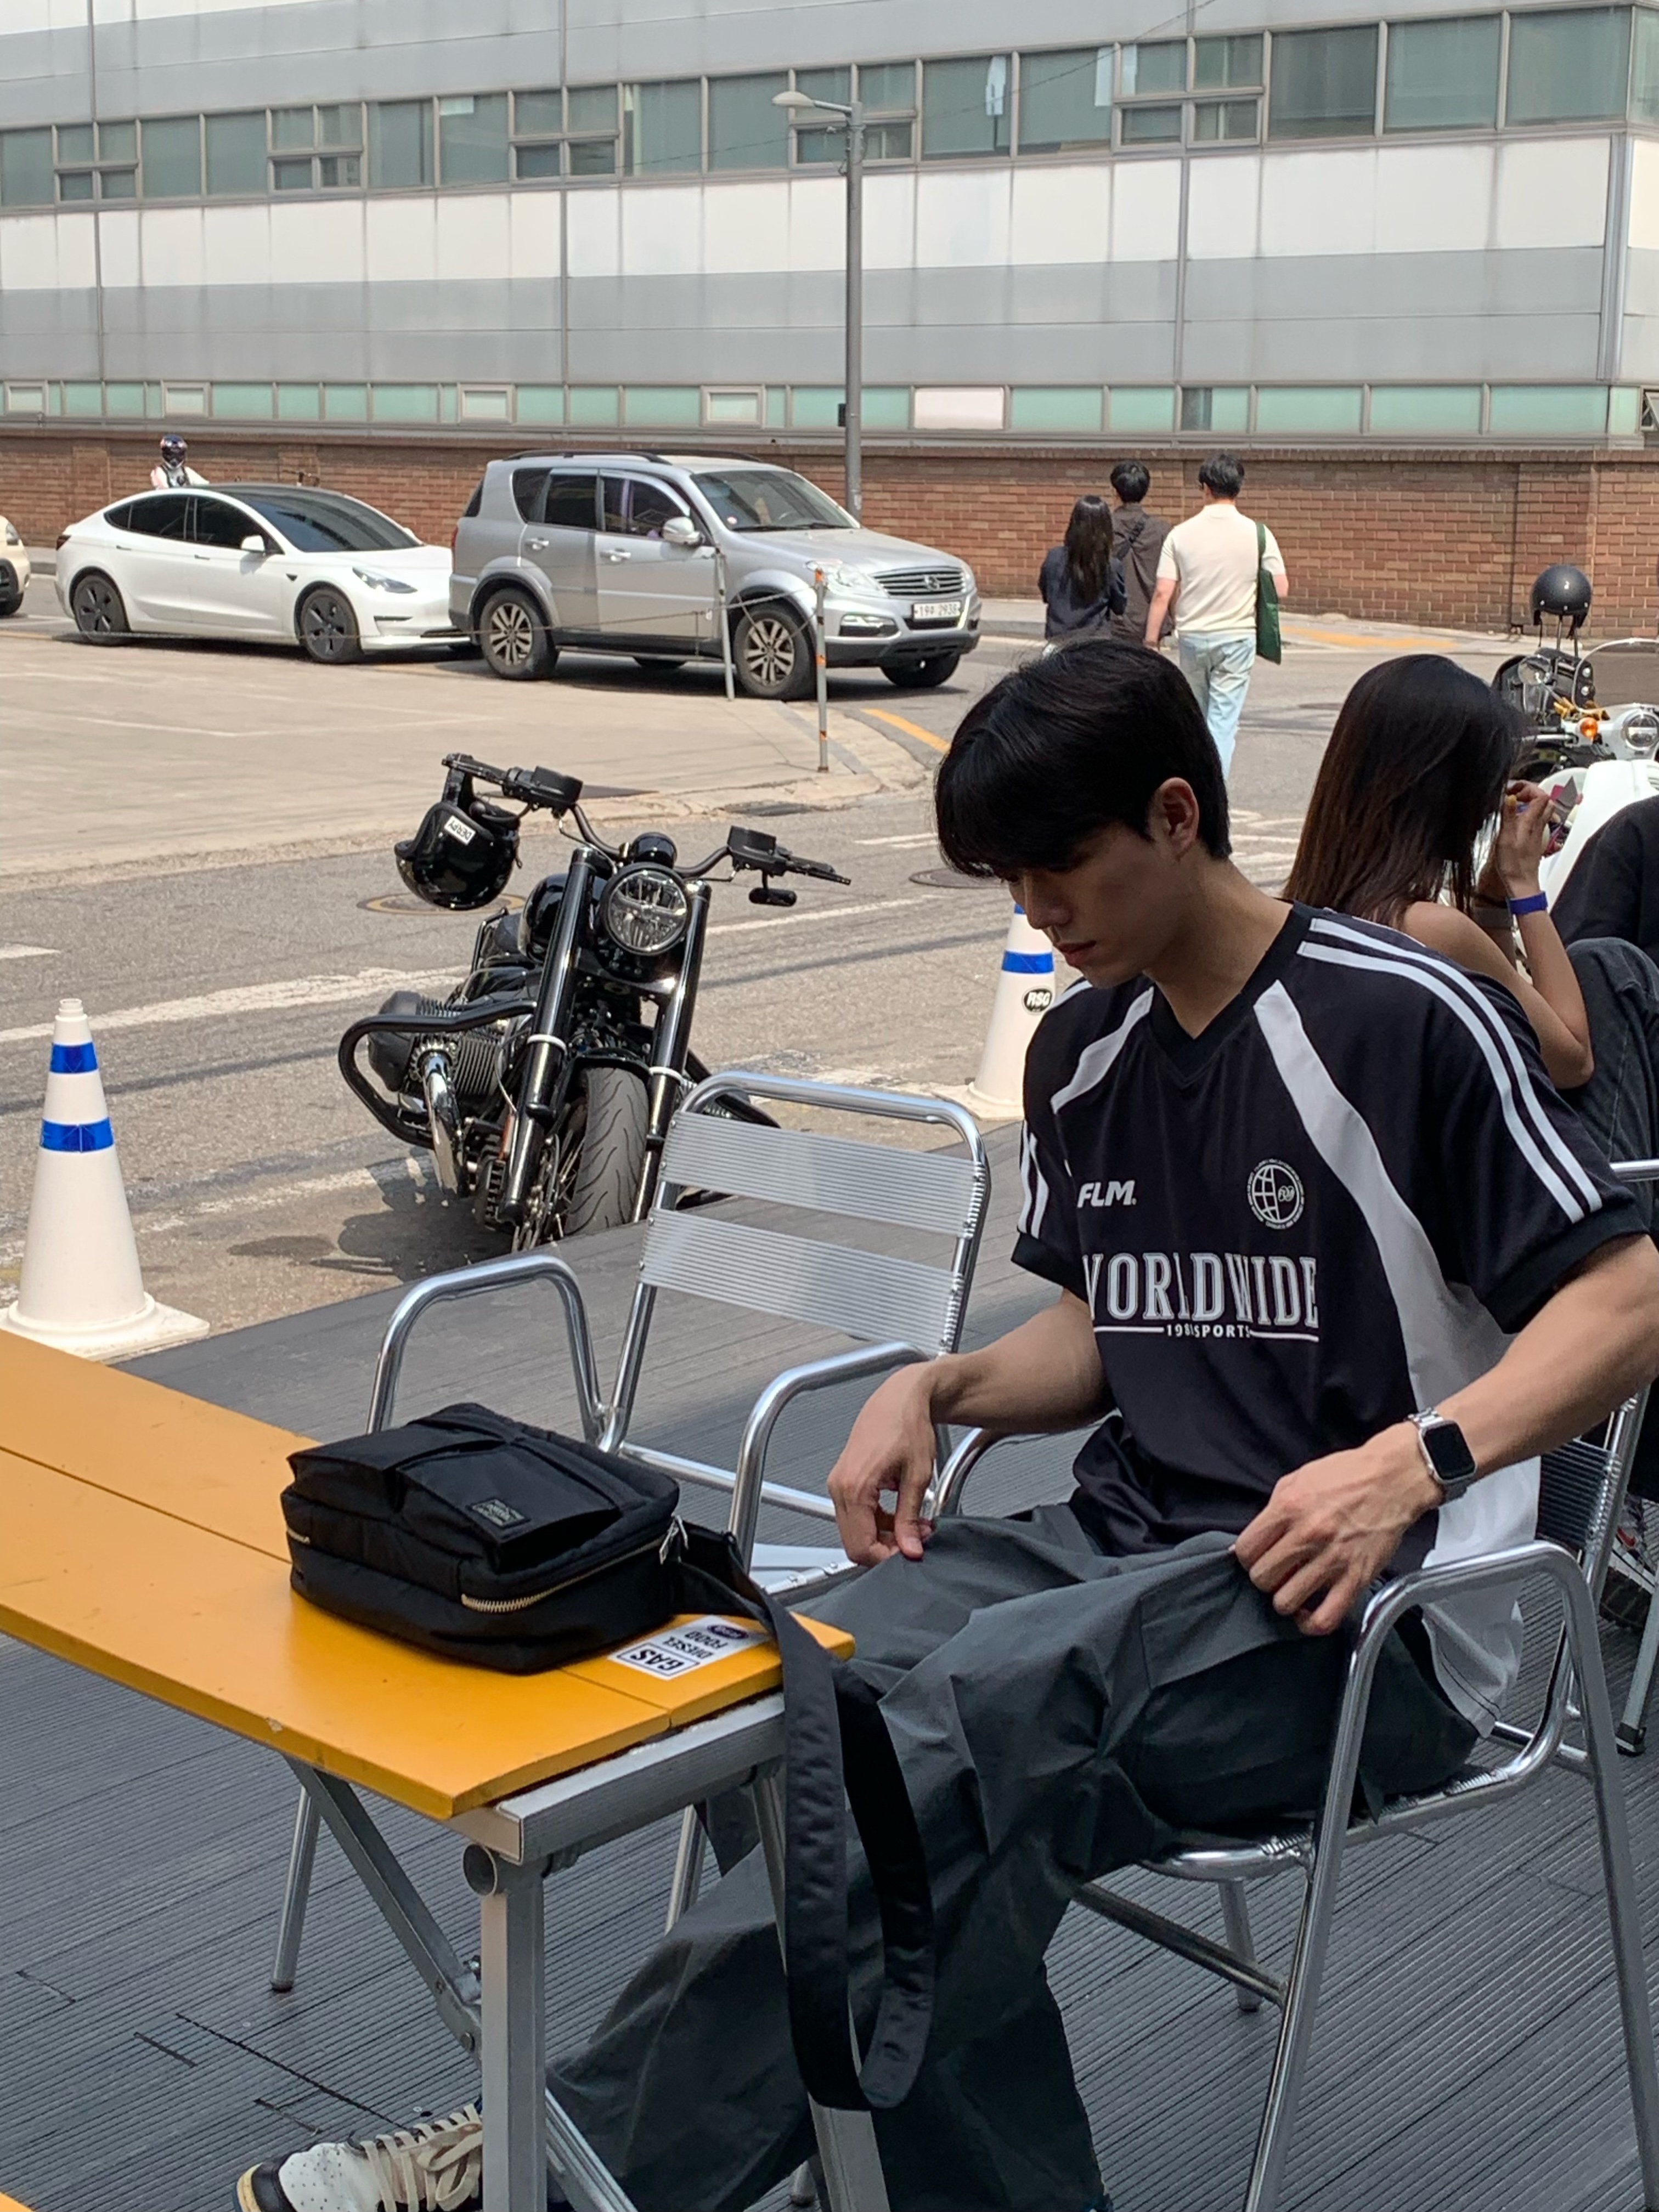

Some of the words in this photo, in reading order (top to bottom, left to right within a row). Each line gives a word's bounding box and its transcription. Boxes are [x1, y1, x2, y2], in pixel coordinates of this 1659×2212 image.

[1077, 1180, 1136, 1208] FLM
[1166, 1323, 1194, 1337] 198
[630, 1648, 685, 1671] GAS
